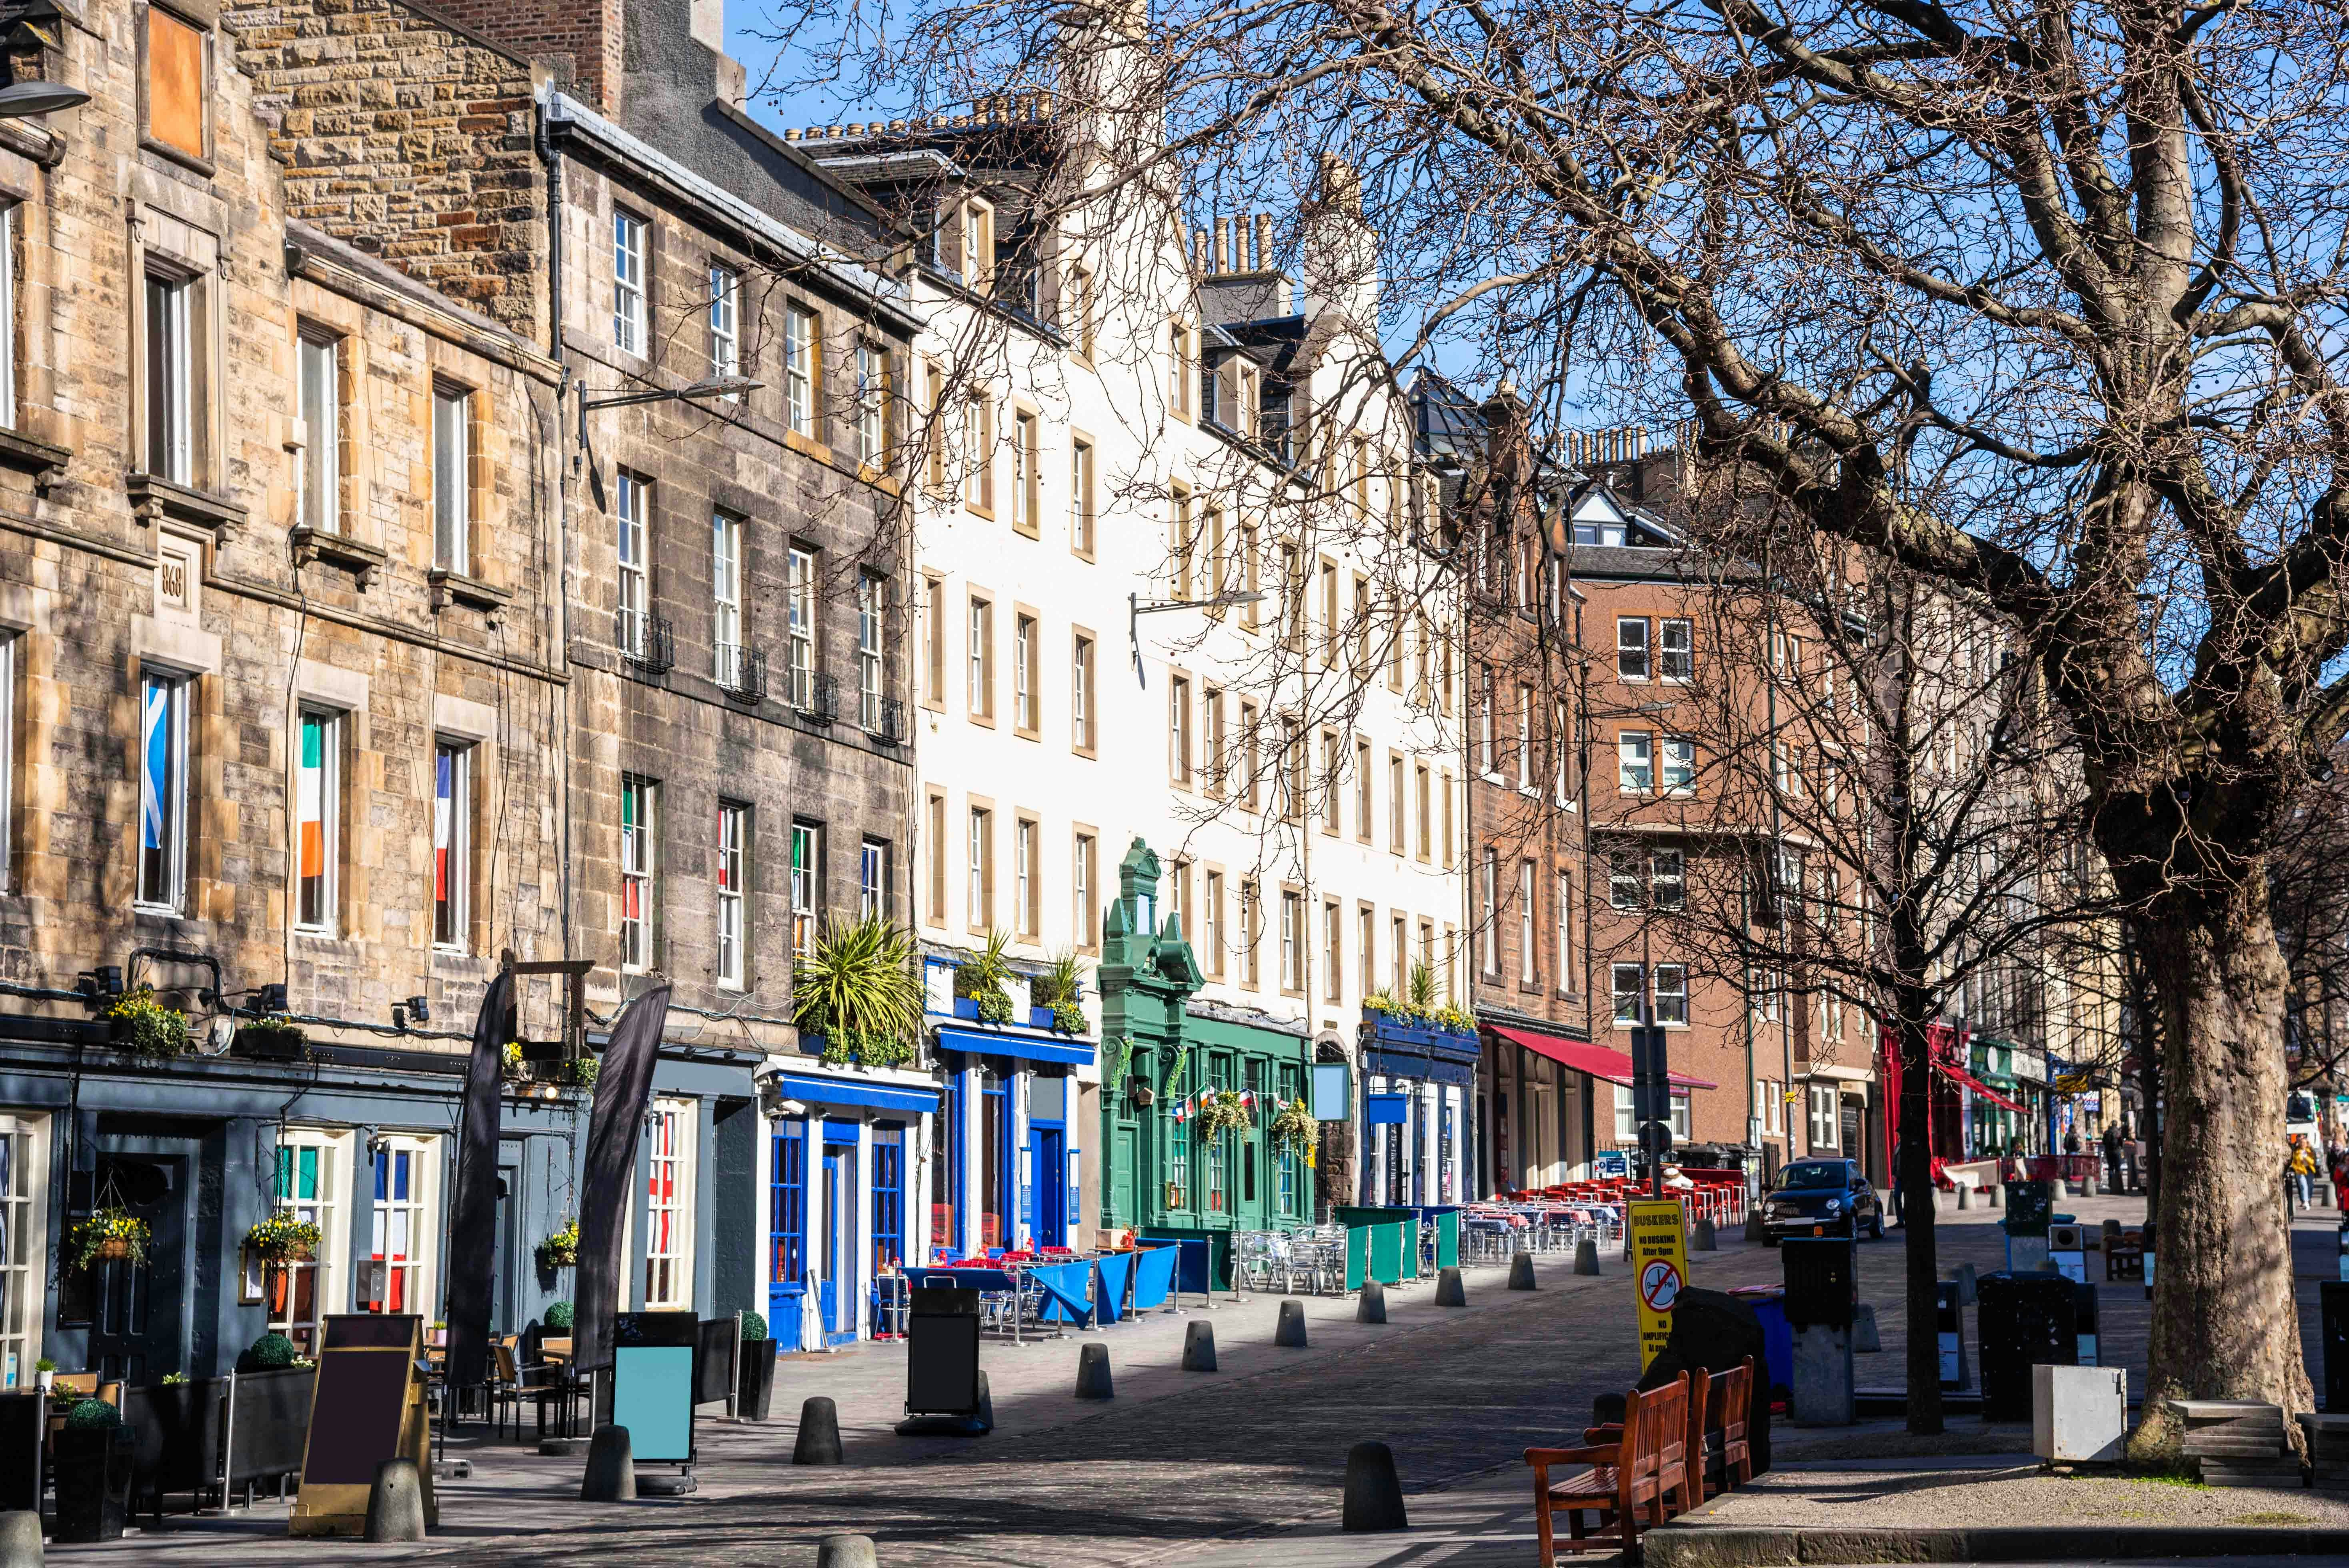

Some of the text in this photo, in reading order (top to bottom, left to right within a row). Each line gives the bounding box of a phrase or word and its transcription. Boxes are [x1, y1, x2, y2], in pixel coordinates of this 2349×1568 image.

[1634, 1214, 1679, 1226] BUSKERS
[1639, 1235, 1676, 1244] NO BUSKING
[1643, 1247, 1673, 1256] After 9pm
[1658, 1320, 1667, 1328] NO
[1649, 1344, 1654, 1352] At
